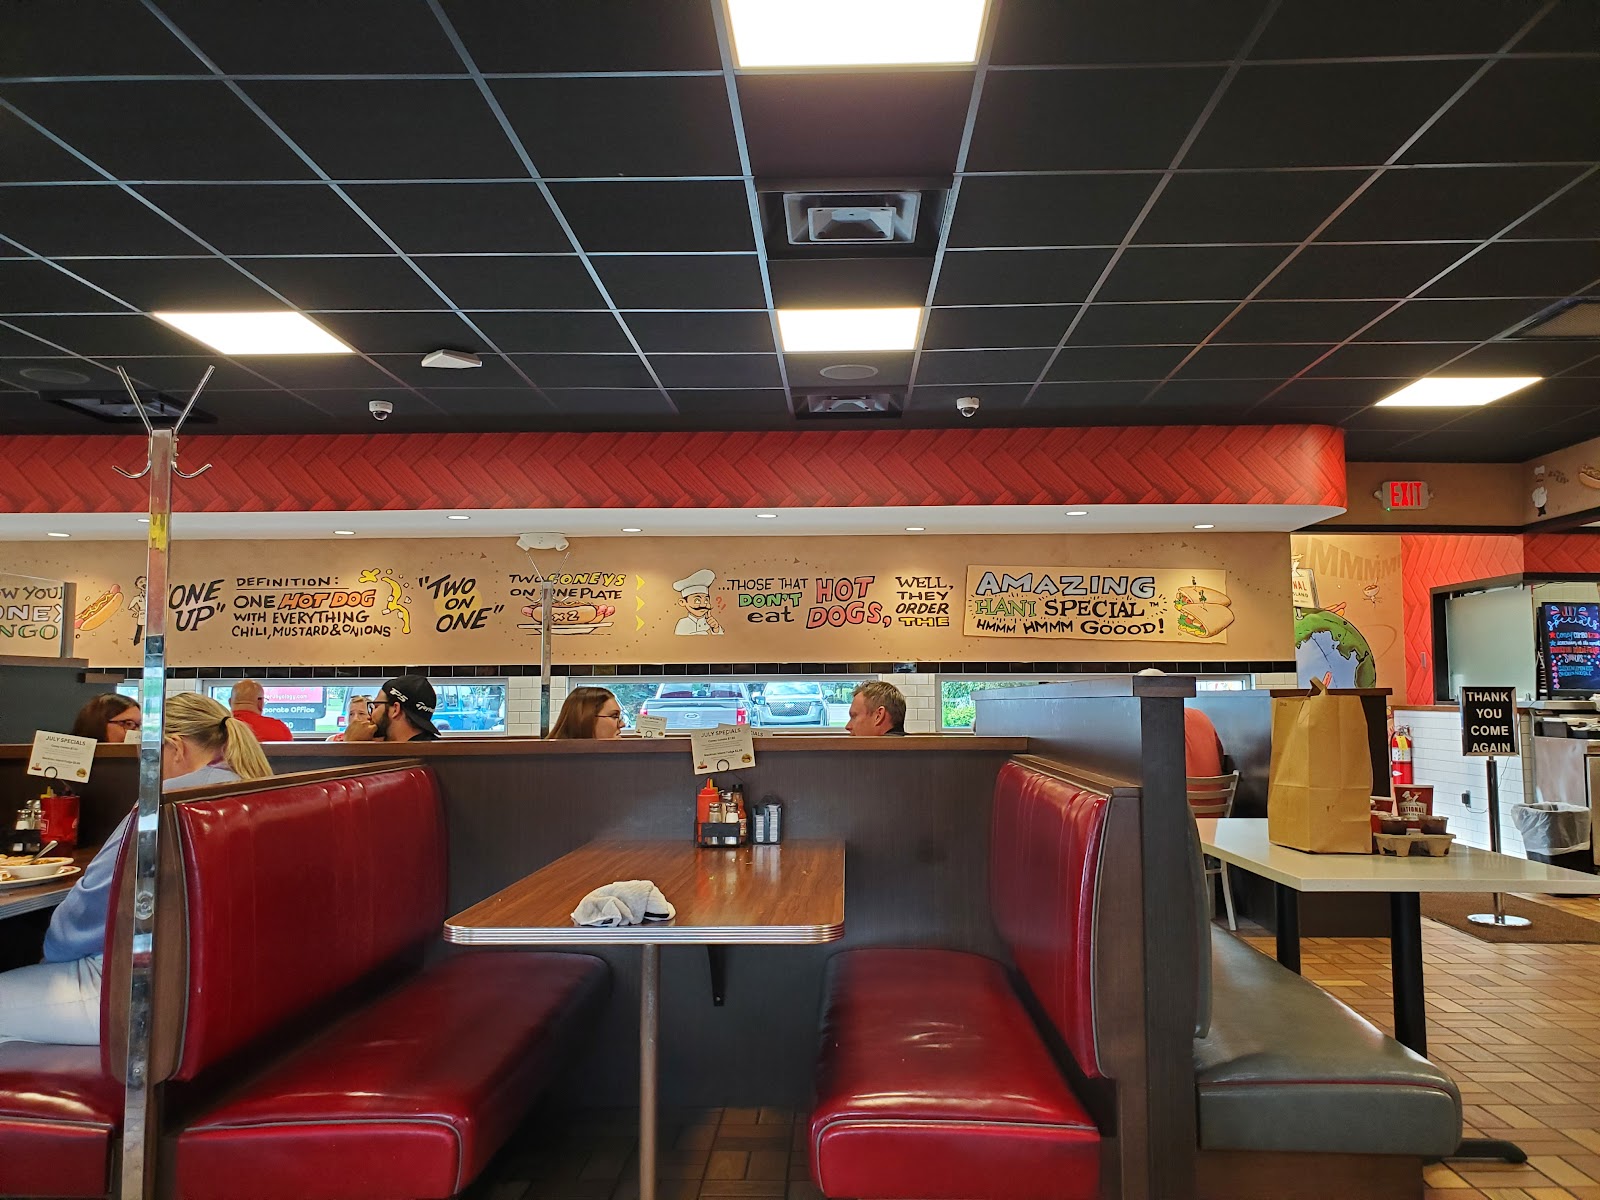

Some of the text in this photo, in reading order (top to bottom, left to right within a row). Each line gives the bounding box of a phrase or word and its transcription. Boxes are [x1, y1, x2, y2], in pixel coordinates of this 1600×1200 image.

[1390, 481, 1422, 507] EXIT
[236, 577, 339, 587] DEFINITION:
[547, 572, 626, 587] CONEYS
[777, 577, 809, 590] THAT
[895, 576, 954, 590] WELL,
[975, 572, 1155, 599] AMAZING
[510, 588, 536, 597] ON
[580, 588, 623, 600] PLATE
[815, 576, 876, 603] HOT
[896, 591, 950, 601] THEY
[233, 589, 376, 610] ONE HOT DOG
[444, 596, 476, 611] ON
[738, 592, 802, 608] DON'T
[747, 605, 796, 623] eat
[806, 601, 892, 629] DOGS,
[895, 602, 950, 615] ORDER
[975, 597, 1037, 618] HANI
[1044, 598, 1146, 619] SPECIAL
[233, 610, 370, 624] WITH EVERYTHING
[899, 616, 950, 627] THE
[976, 619, 1016, 634] HMMM
[1023, 619, 1073, 634] HMMM
[1466, 691, 1510, 702] THANK
[1475, 708, 1503, 719] YOU
[715, 728, 741, 736] SPECIALS
[1470, 725, 1510, 736] COME
[60, 737, 86, 746] SPECIALS
[1471, 742, 1511, 753] AGAIN
